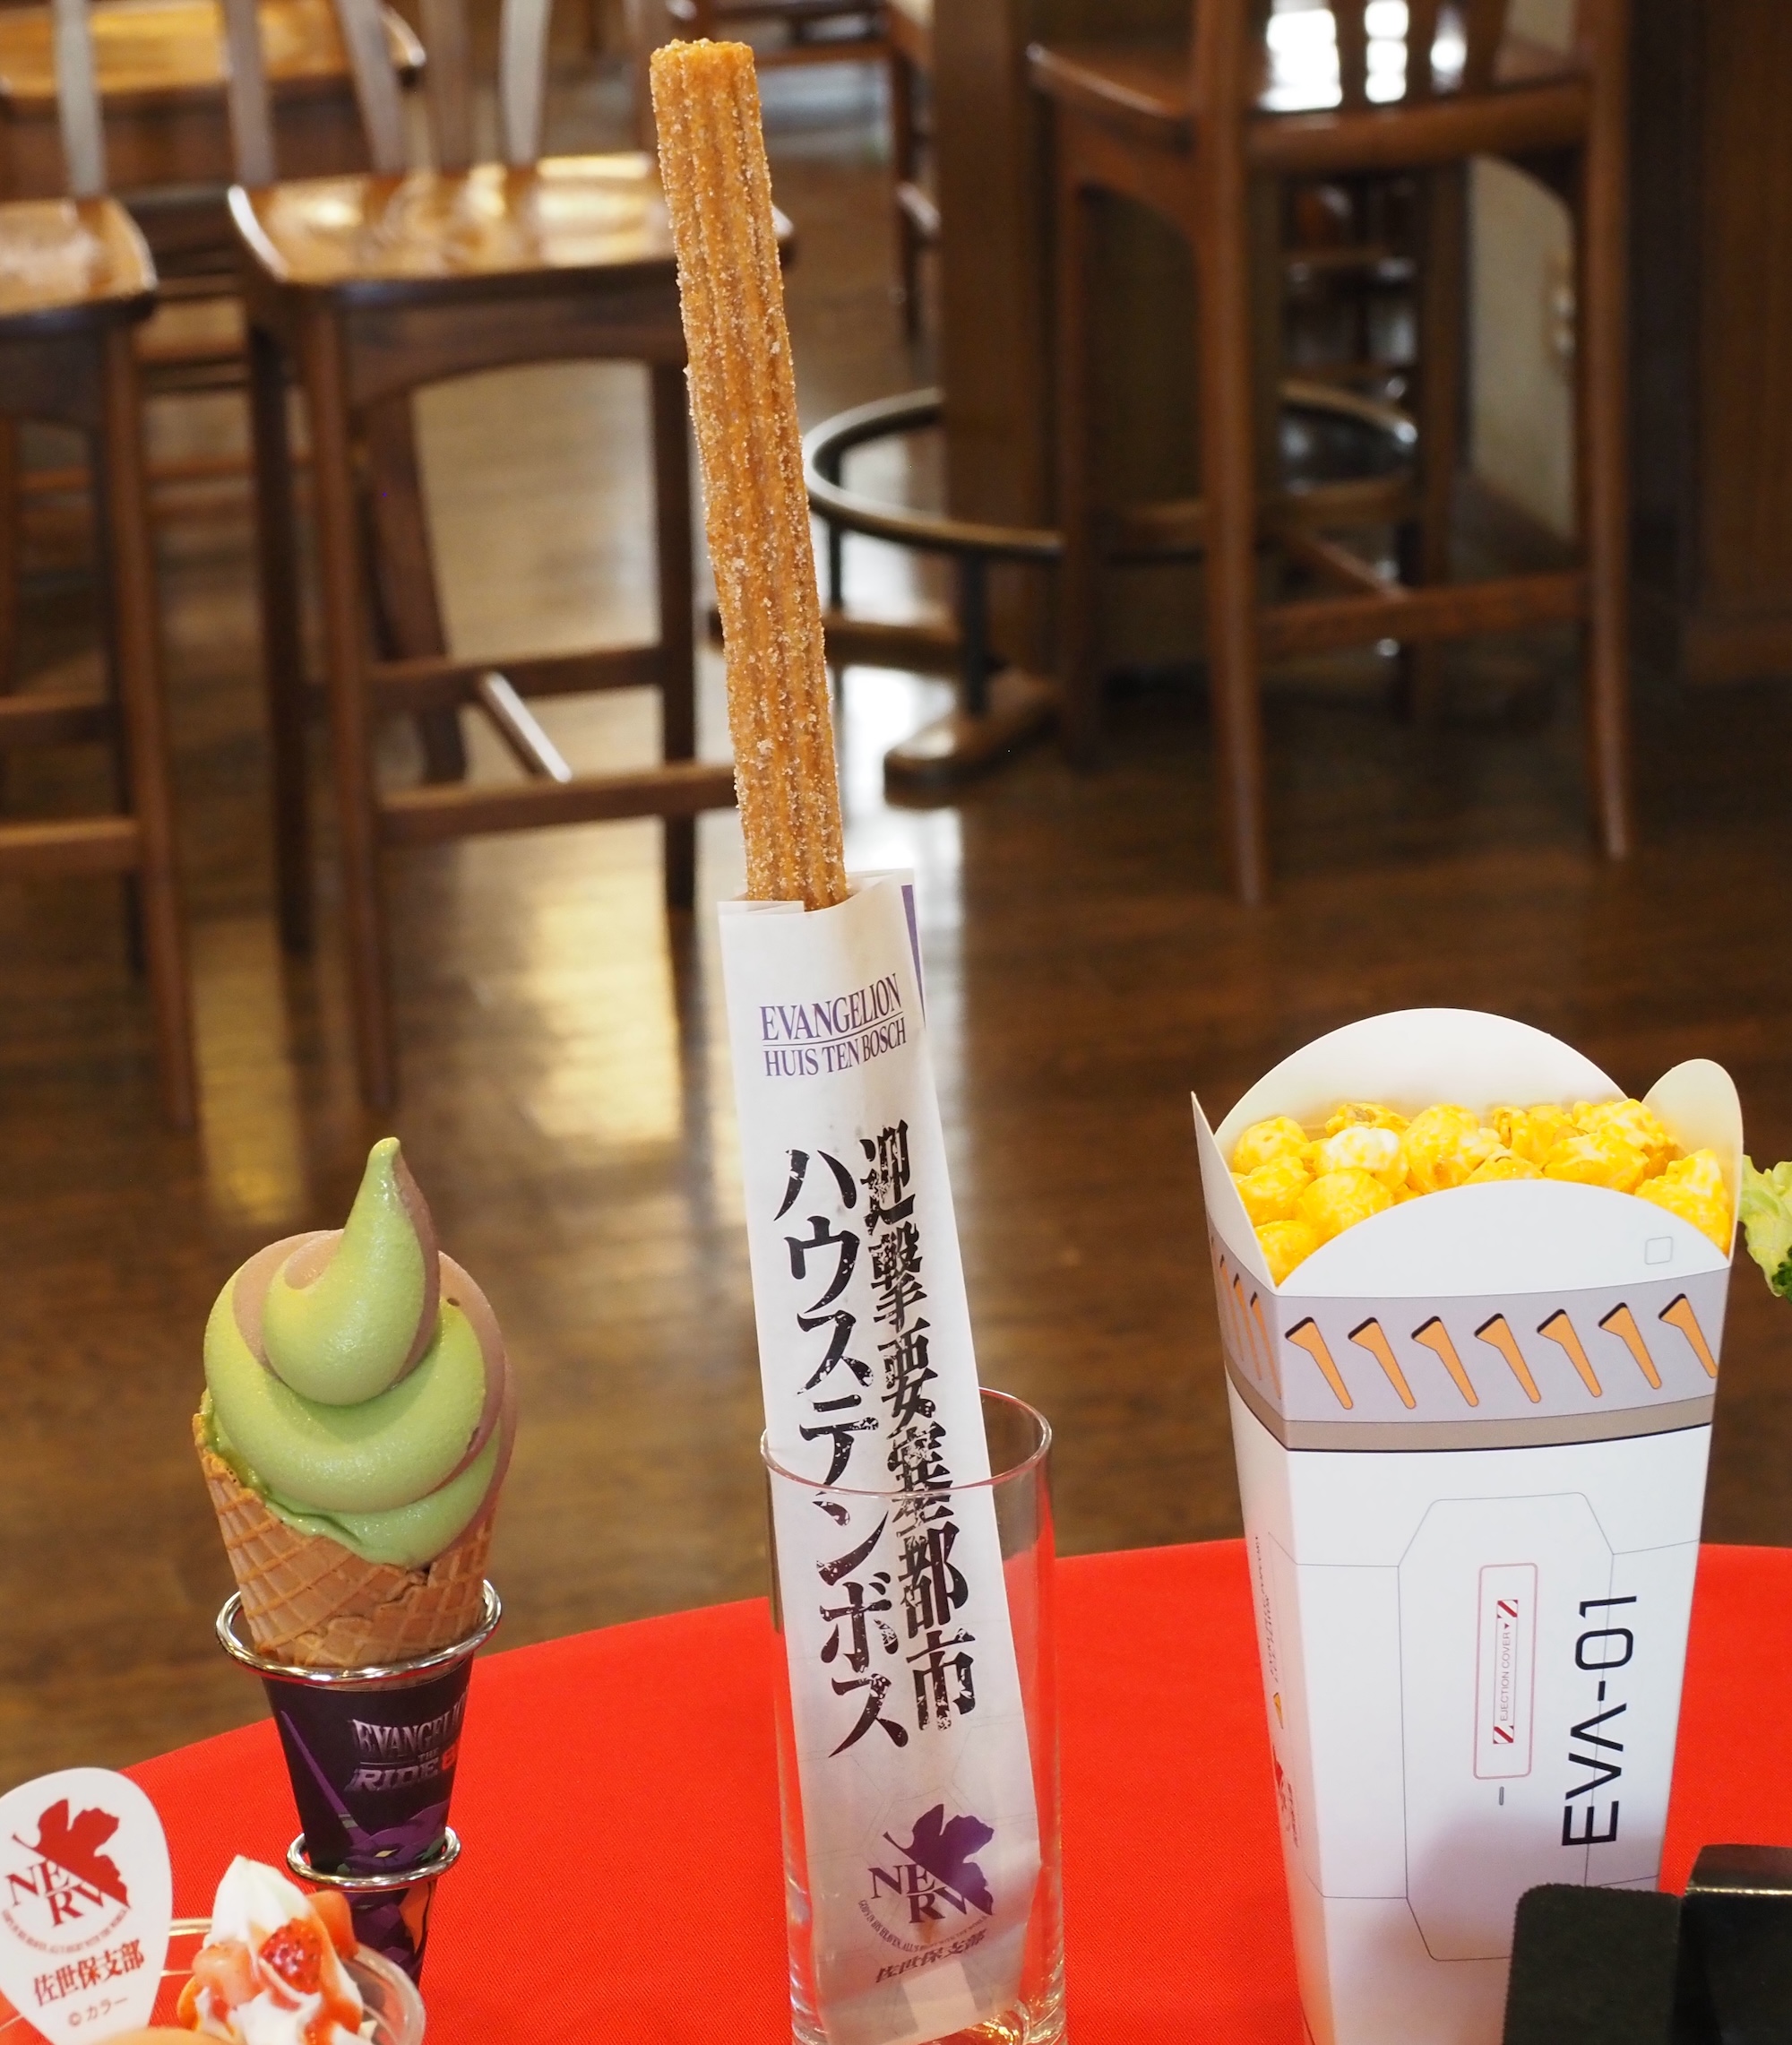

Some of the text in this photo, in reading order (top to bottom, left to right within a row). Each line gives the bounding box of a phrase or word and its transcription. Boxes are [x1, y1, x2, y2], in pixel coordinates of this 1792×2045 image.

[759, 972, 903, 1041] EVANGELION
[762, 1017, 907, 1077] HUIS TEN BOSCH
[773, 1149, 909, 1758] ハウステンボス
[859, 1118, 976, 1731] 迎撃要塞都市
[1500, 1632, 1511, 1721] EJECTION COVER
[1562, 1595, 1637, 1846] EVA-01
[344, 1756, 439, 1791] RIDE
[5, 1860, 104, 1927] NERV
[867, 1863, 967, 1924] NERV
[34, 1938, 144, 2006] 佐世保支部
